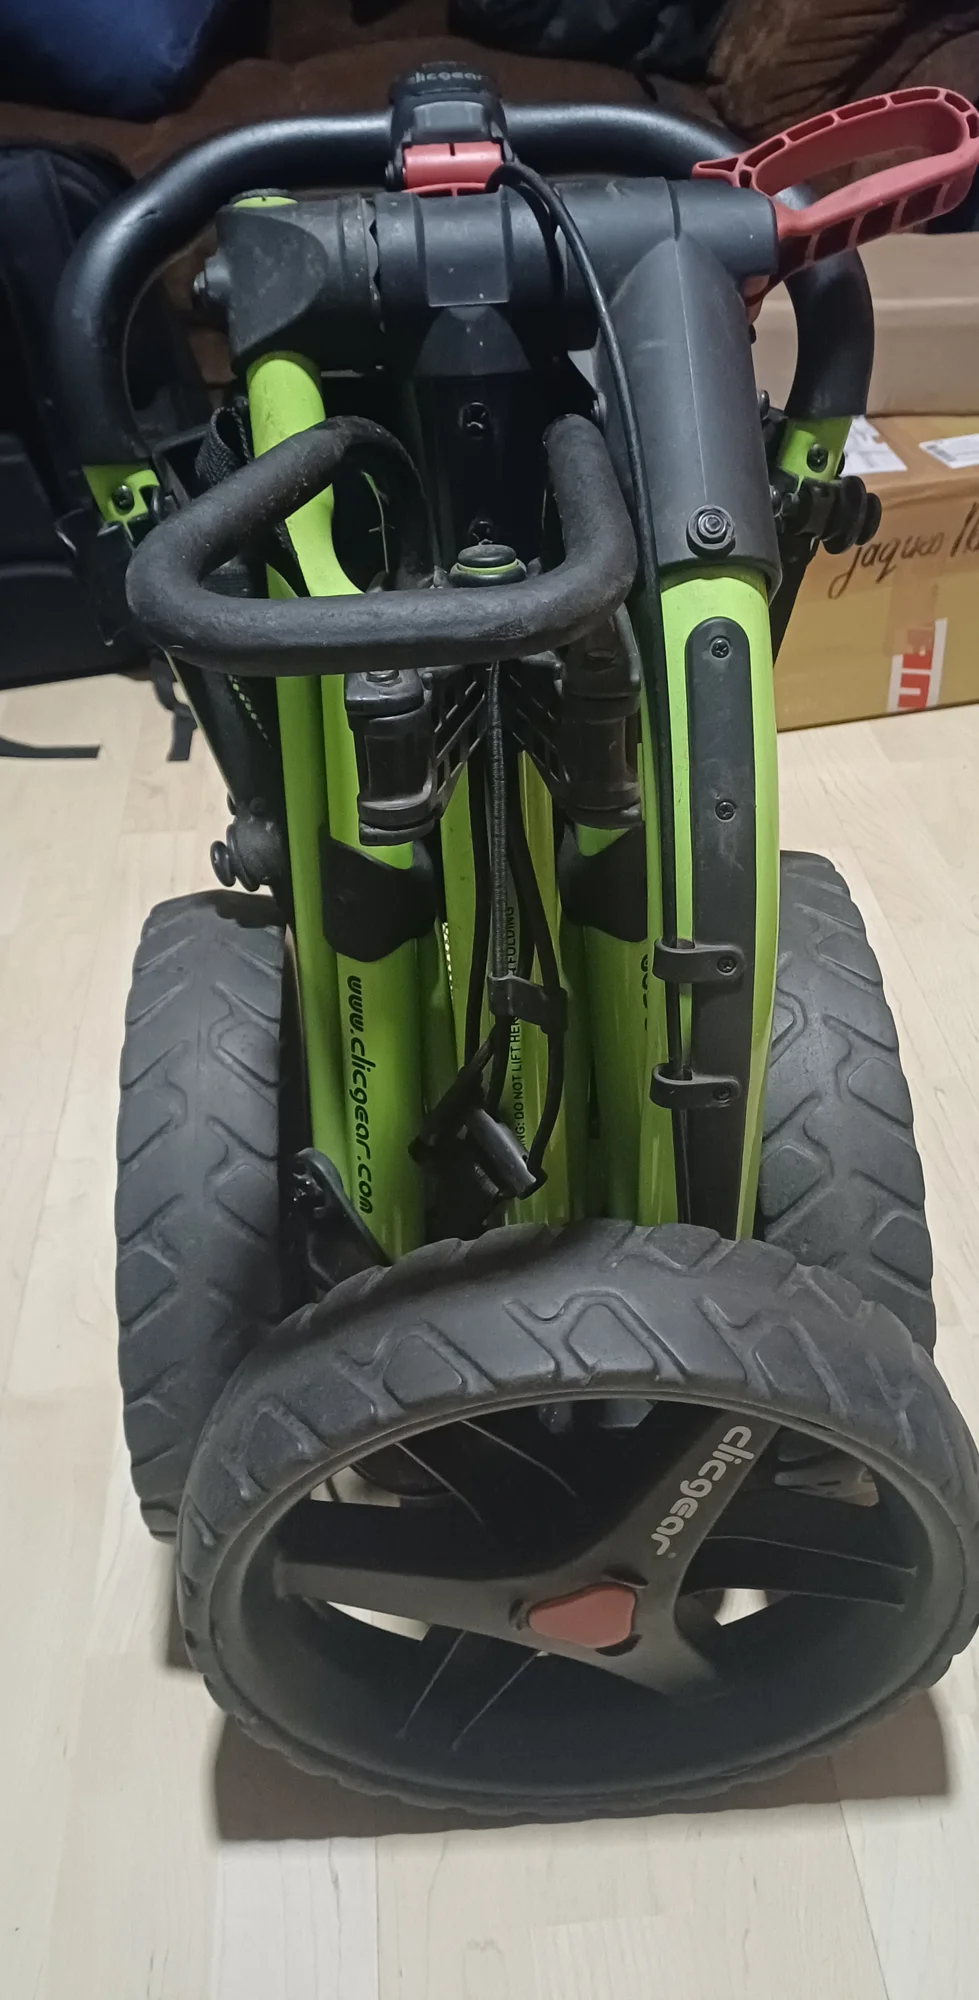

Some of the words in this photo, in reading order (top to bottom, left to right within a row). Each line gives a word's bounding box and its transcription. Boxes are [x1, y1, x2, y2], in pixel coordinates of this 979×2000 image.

[505, 906, 517, 964] FOLDING
[510, 1045, 523, 1072] LIFT
[346, 975, 376, 1214] www.clicgear.com
[511, 1075, 524, 1100] NOT
[514, 1103, 525, 1120] DO
[651, 1425, 755, 1556] clicgear
